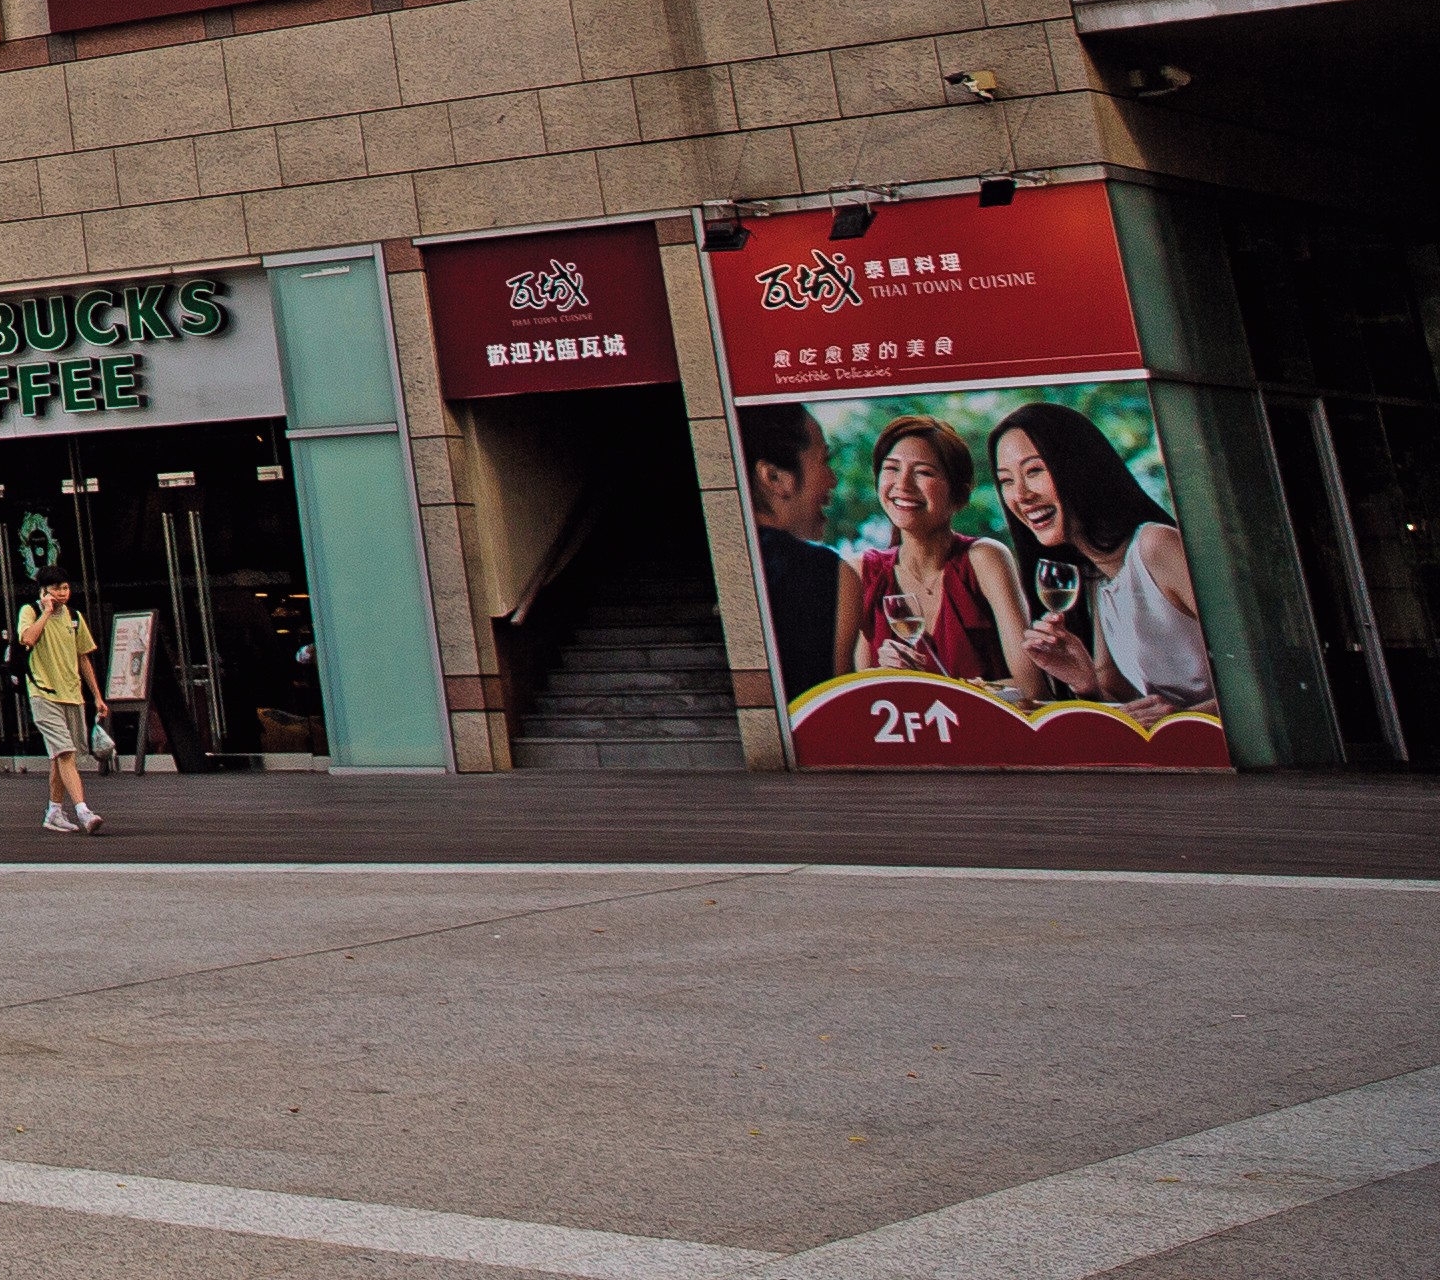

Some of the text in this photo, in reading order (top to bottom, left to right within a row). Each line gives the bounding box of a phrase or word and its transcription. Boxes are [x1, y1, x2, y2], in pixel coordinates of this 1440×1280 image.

[755, 249, 863, 313] 瓦城
[863, 252, 962, 280] 泰國料理
[506, 259, 589, 312] 瓦城
[869, 271, 1037, 299] THAI TOWN CUISINE
[486, 334, 627, 367] 歡迎光臨瓦城
[773, 336, 954, 368] 愈吃愈愛的美食
[873, 698, 928, 744] 2F
